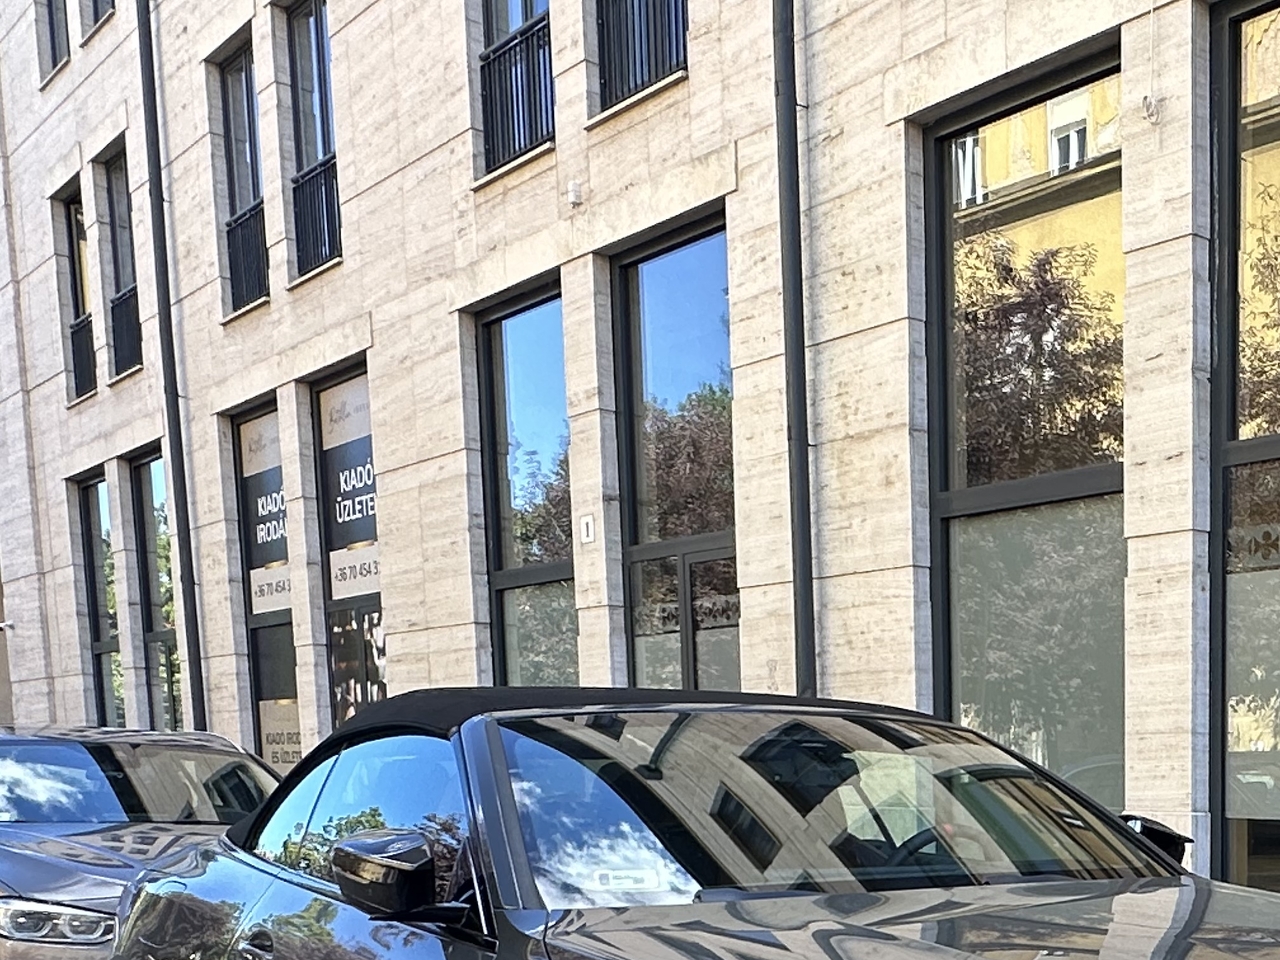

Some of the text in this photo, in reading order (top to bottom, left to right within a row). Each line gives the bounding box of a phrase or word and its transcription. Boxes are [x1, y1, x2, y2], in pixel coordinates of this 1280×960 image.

[339, 457, 374, 493] KIADÓ
[257, 485, 286, 517] KIADÓ
[348, 564, 357, 580] 70
